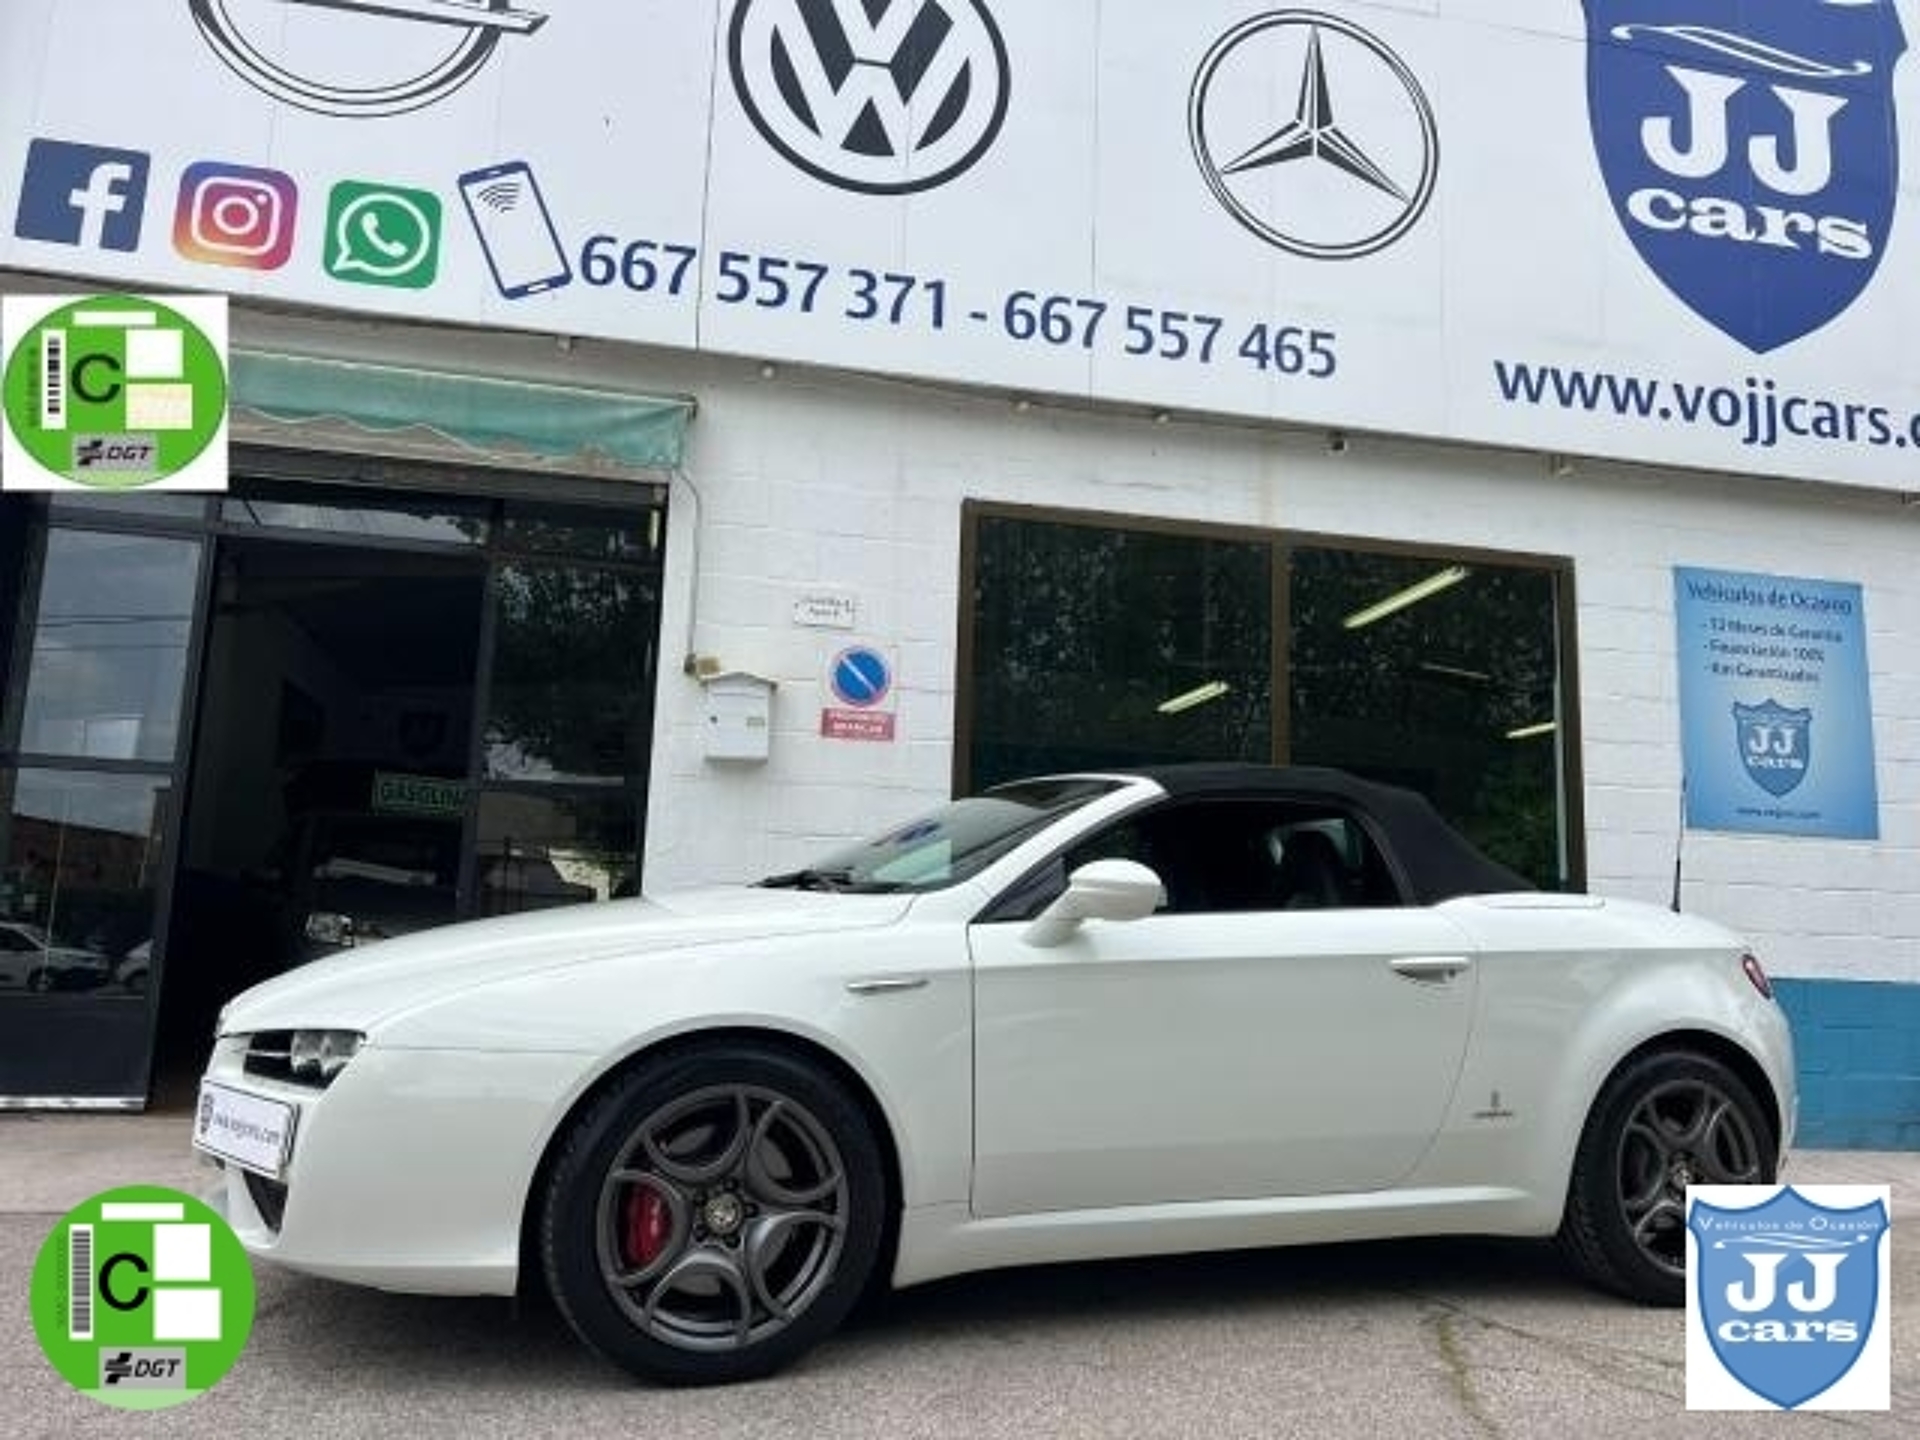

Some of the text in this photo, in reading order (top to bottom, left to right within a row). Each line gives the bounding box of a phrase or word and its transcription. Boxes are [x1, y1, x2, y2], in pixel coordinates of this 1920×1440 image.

[1641, 65, 1849, 196] JJ
[1627, 187, 1872, 260] cars
[580, 235, 697, 295] 667
[716, 251, 829, 313] 557
[845, 269, 945, 329] 371
[1003, 291, 1107, 349] 667
[1124, 306, 1222, 364] 557
[1238, 323, 1336, 379] 465
